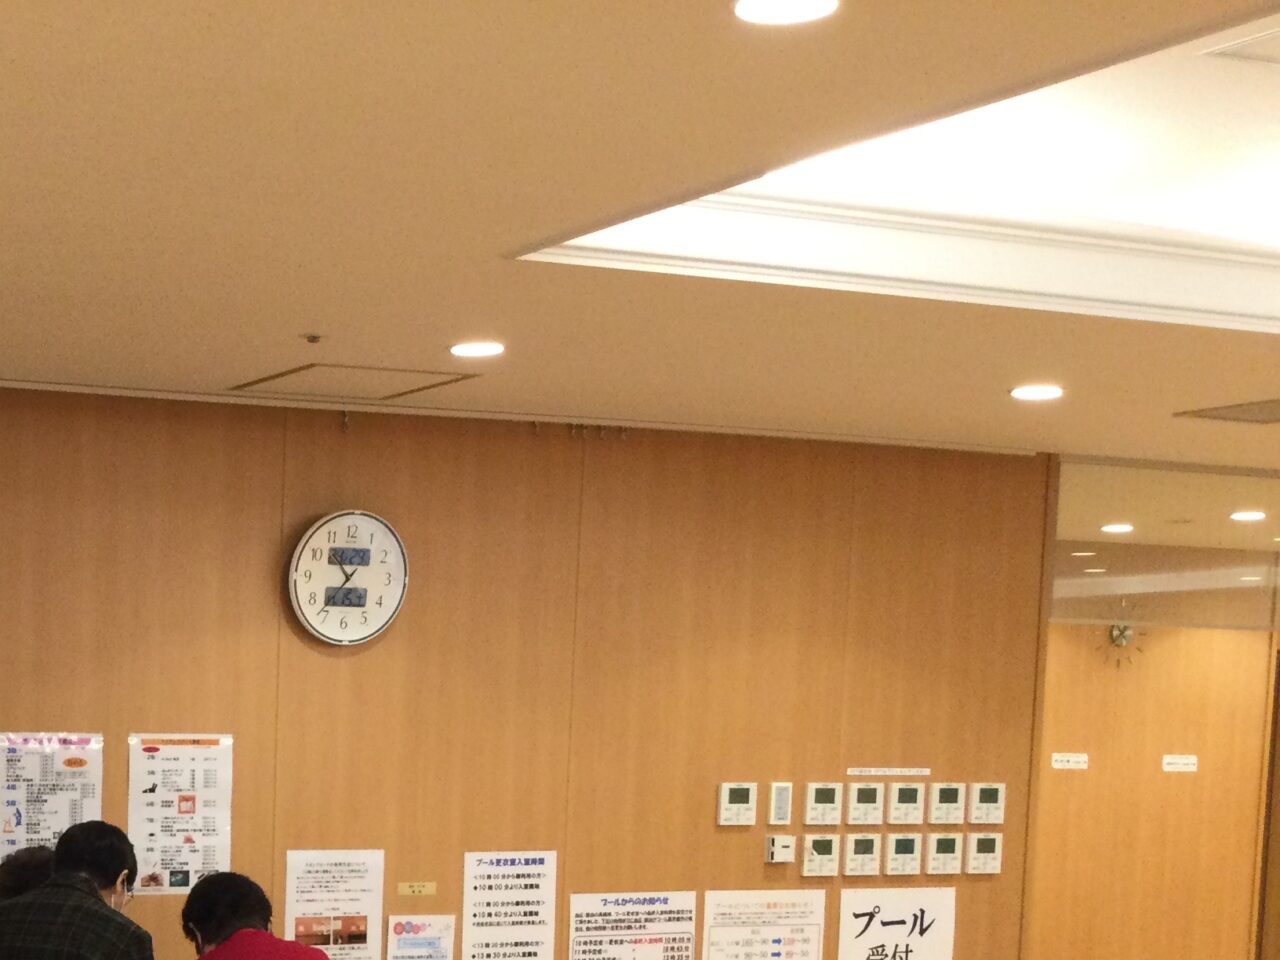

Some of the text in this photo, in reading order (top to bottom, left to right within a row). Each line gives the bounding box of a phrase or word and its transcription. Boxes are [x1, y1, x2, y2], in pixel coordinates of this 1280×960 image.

[327, 531, 337, 543] 11
[347, 525, 358, 539] 12
[370, 533, 374, 545] 1
[311, 548, 323, 561] 10
[380, 549, 388, 563] 2
[304, 570, 312, 583] 9
[384, 572, 391, 586] 3
[308, 592, 316, 605] 8
[375, 595, 383, 608] 4
[320, 610, 329, 624] 7
[340, 616, 348, 630] 6
[360, 611, 367, 624] 5
[852, 905, 936, 939] プール
